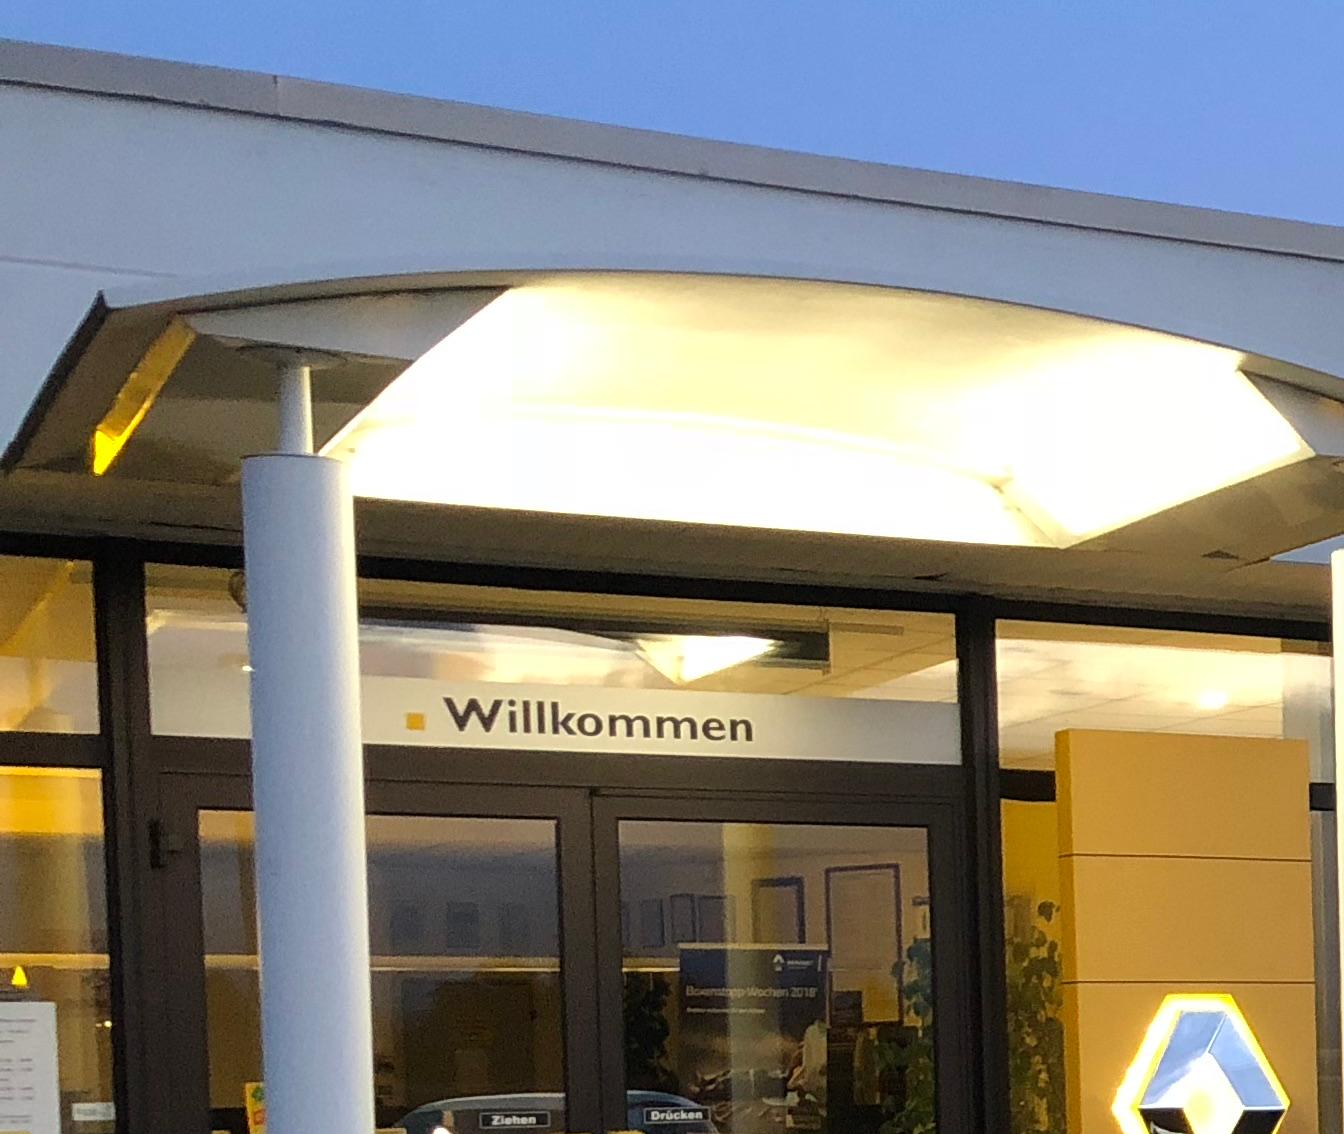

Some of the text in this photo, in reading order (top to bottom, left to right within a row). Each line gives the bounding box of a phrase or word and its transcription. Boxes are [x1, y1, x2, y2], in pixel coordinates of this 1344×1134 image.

[442, 697, 754, 741] Willkommen
[491, 1115, 537, 1126] Ziehen
[651, 1109, 703, 1121] Drücken
